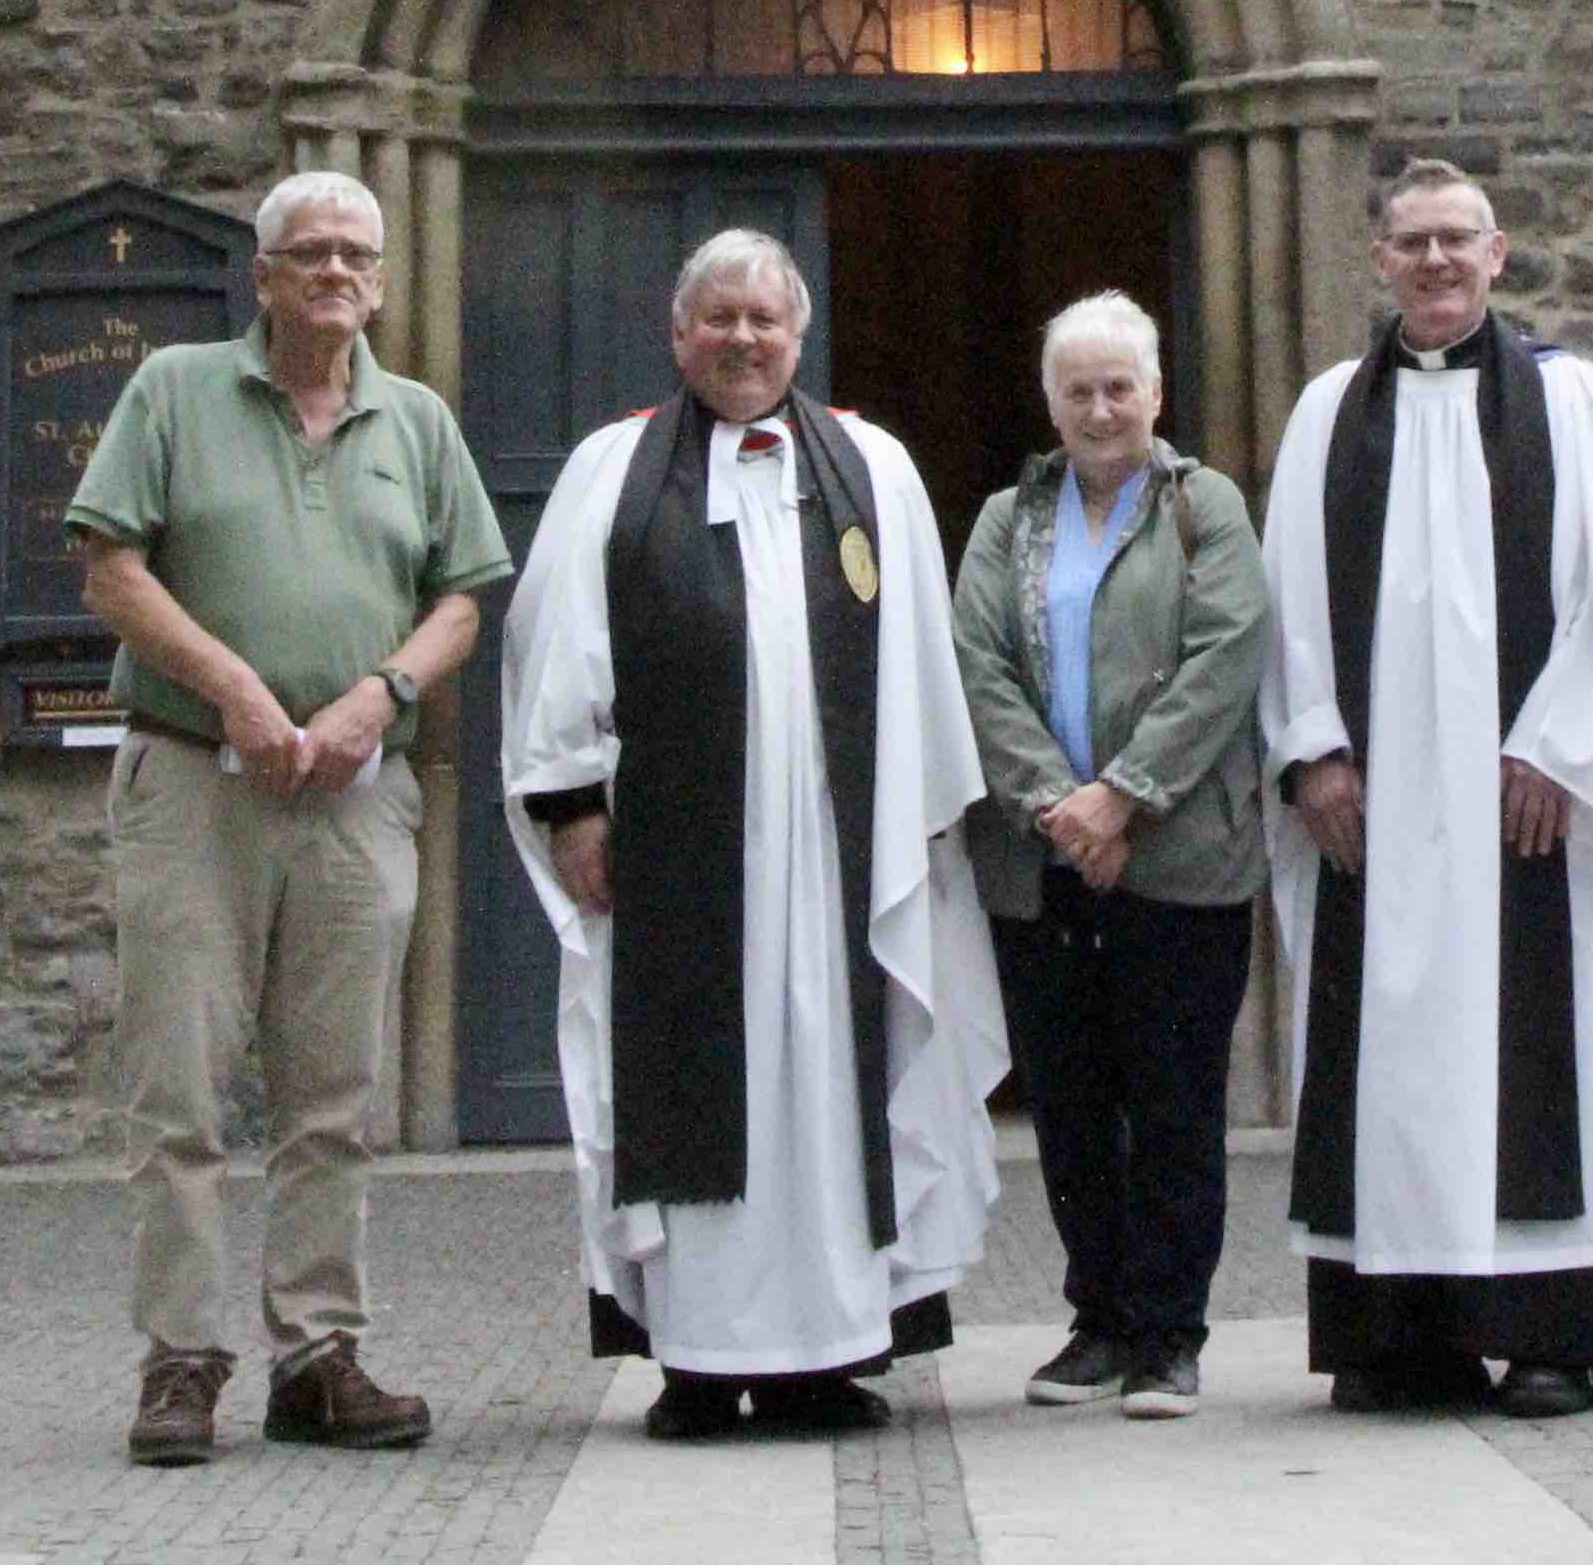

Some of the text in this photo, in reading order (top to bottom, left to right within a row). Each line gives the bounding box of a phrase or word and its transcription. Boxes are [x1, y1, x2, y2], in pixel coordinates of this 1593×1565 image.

[105, 317, 139, 336] The
[25, 340, 104, 377] Church
[111, 343, 133, 360] of
